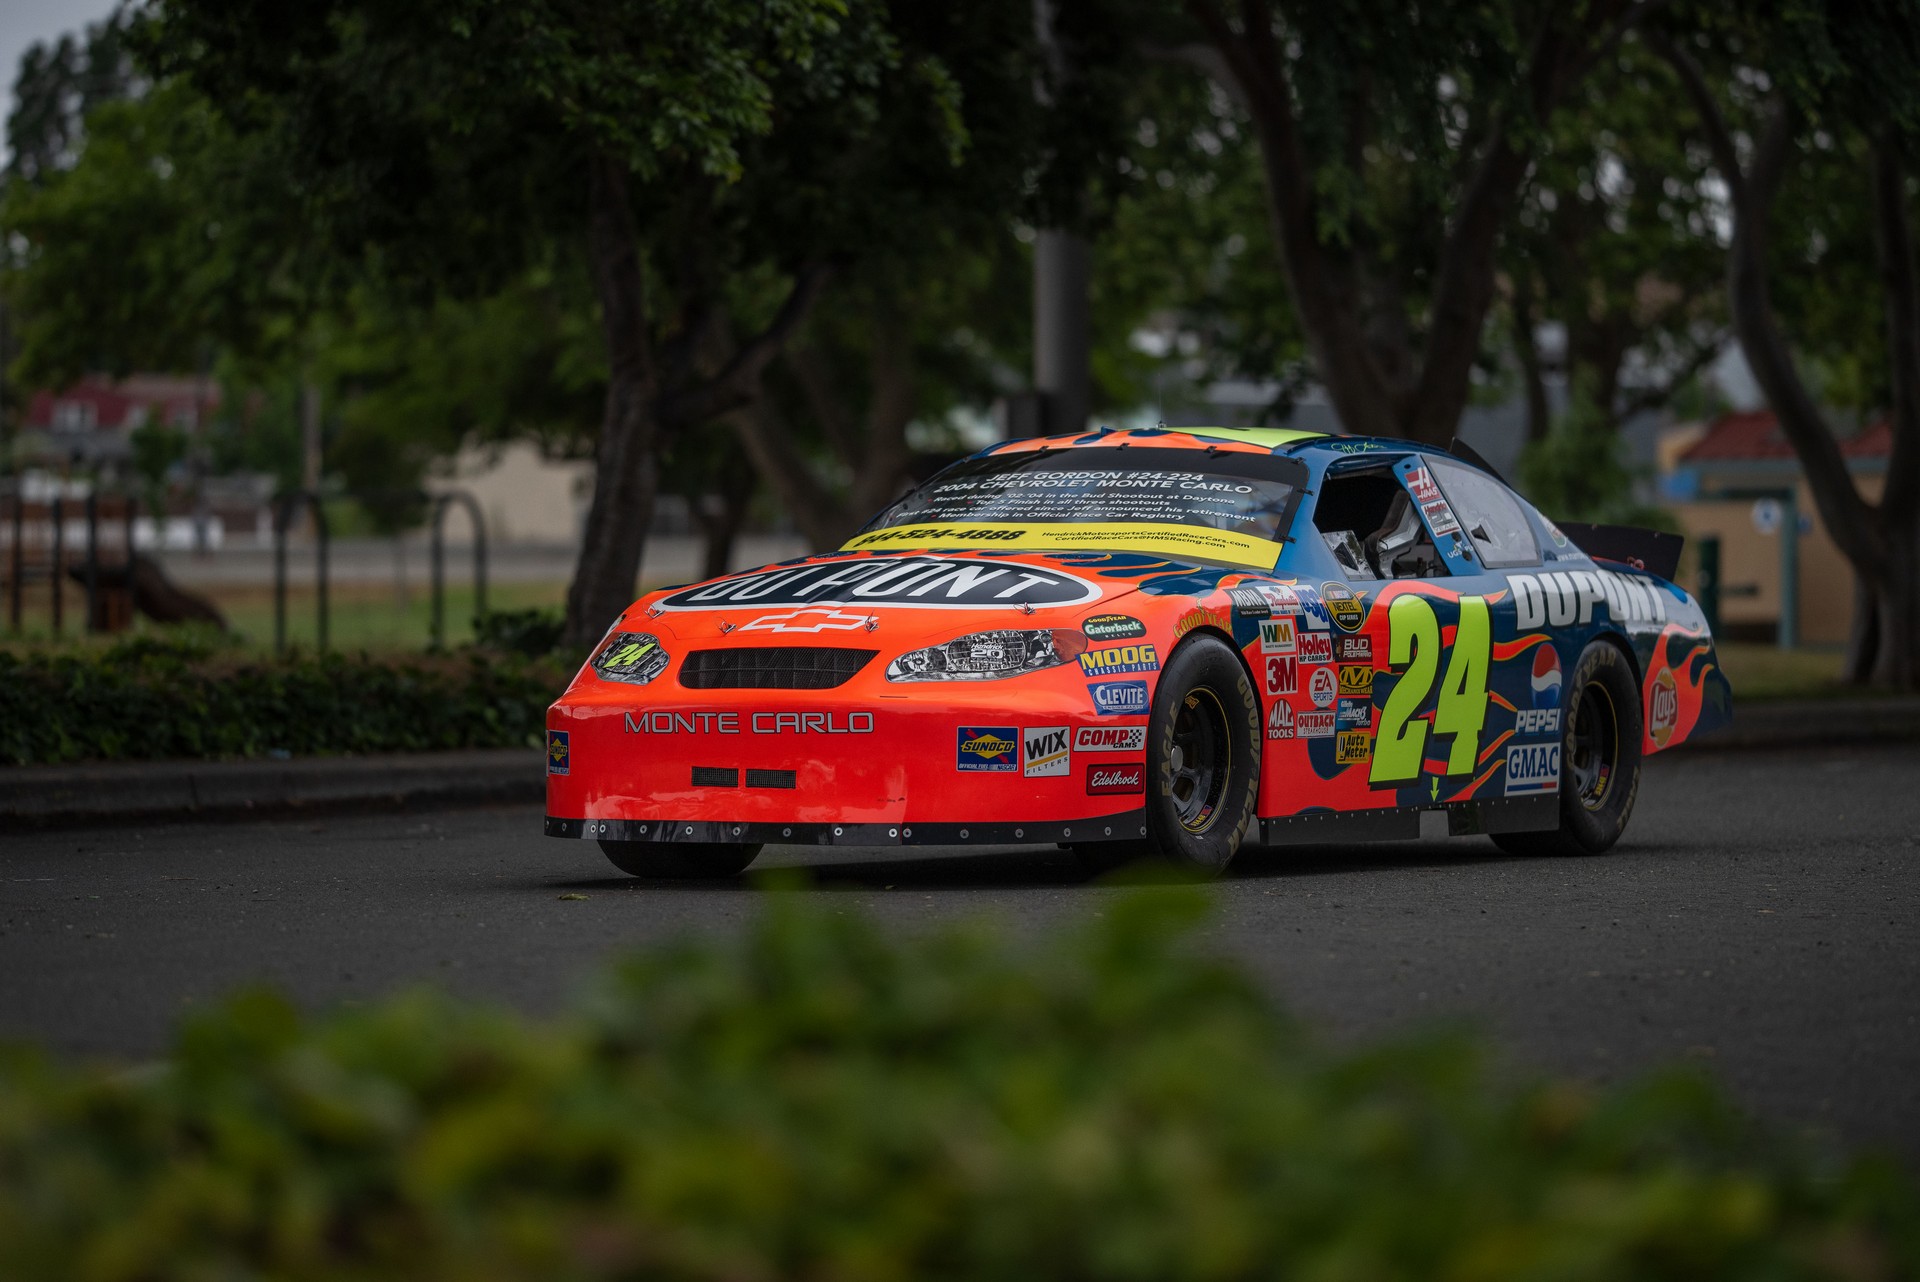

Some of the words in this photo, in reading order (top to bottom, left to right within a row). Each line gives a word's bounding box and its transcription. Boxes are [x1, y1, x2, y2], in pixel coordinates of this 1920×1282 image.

[986, 472, 1029, 482] JEFF
[1033, 471, 1122, 481] GORDON
[1127, 471, 1204, 482] #24-224
[933, 482, 976, 494] 2004
[979, 479, 1094, 490] CHEVROLET
[1096, 479, 1174, 489] MONTE
[1179, 481, 1252, 494] CARLO
[933, 494, 966, 502] Raced
[967, 493, 1001, 501] during
[1182, 494, 1235, 504] Daytona
[939, 511, 1009, 519] Membership
[1131, 512, 1186, 521] Registry
[1186, 508, 1256, 522] retirement
[1042, 531, 1250, 549] HendrickMotorsportsCertifiedRaceCars.com
[1054, 535, 1226, 549] CertifiedRaceCars@HMSRacing.com
[1333, 602, 1357, 612] NEXTEL
[1506, 570, 1667, 631] DUPONT
[1084, 621, 1141, 635] Gatorback
[1262, 624, 1292, 643] WM
[1297, 634, 1331, 661] Holley
[1344, 638, 1368, 650] BUD
[603, 643, 656, 668] 24
[970, 649, 1004, 659] 20
[1080, 645, 1156, 670] MOOG
[1088, 665, 1127, 676] CHASSIS
[1132, 663, 1157, 671] PARTS
[1268, 657, 1297, 693] 3M
[1314, 671, 1333, 691] EA
[1096, 685, 1144, 705] CLEVITE
[1314, 692, 1333, 701] SPORTS
[1369, 594, 1491, 786] 24
[1269, 699, 1294, 727] MAC
[1299, 714, 1334, 728] OUTBACK
[1515, 708, 1561, 734] PEPSI
[624, 711, 740, 734] MONTE
[751, 711, 875, 734] CARLO
[1079, 729, 1129, 746] COMP
[1268, 729, 1294, 738] TOOLS
[1347, 735, 1365, 745] Auto
[964, 741, 1014, 752] SUNOCO
[1025, 728, 1068, 760] WIX
[1160, 700, 1179, 797] EAGLE
[1345, 745, 1368, 758] Meter
[1026, 757, 1068, 775] FILTERS
[1508, 746, 1559, 779] GMAC
[1091, 771, 1139, 788] Edelbrock
